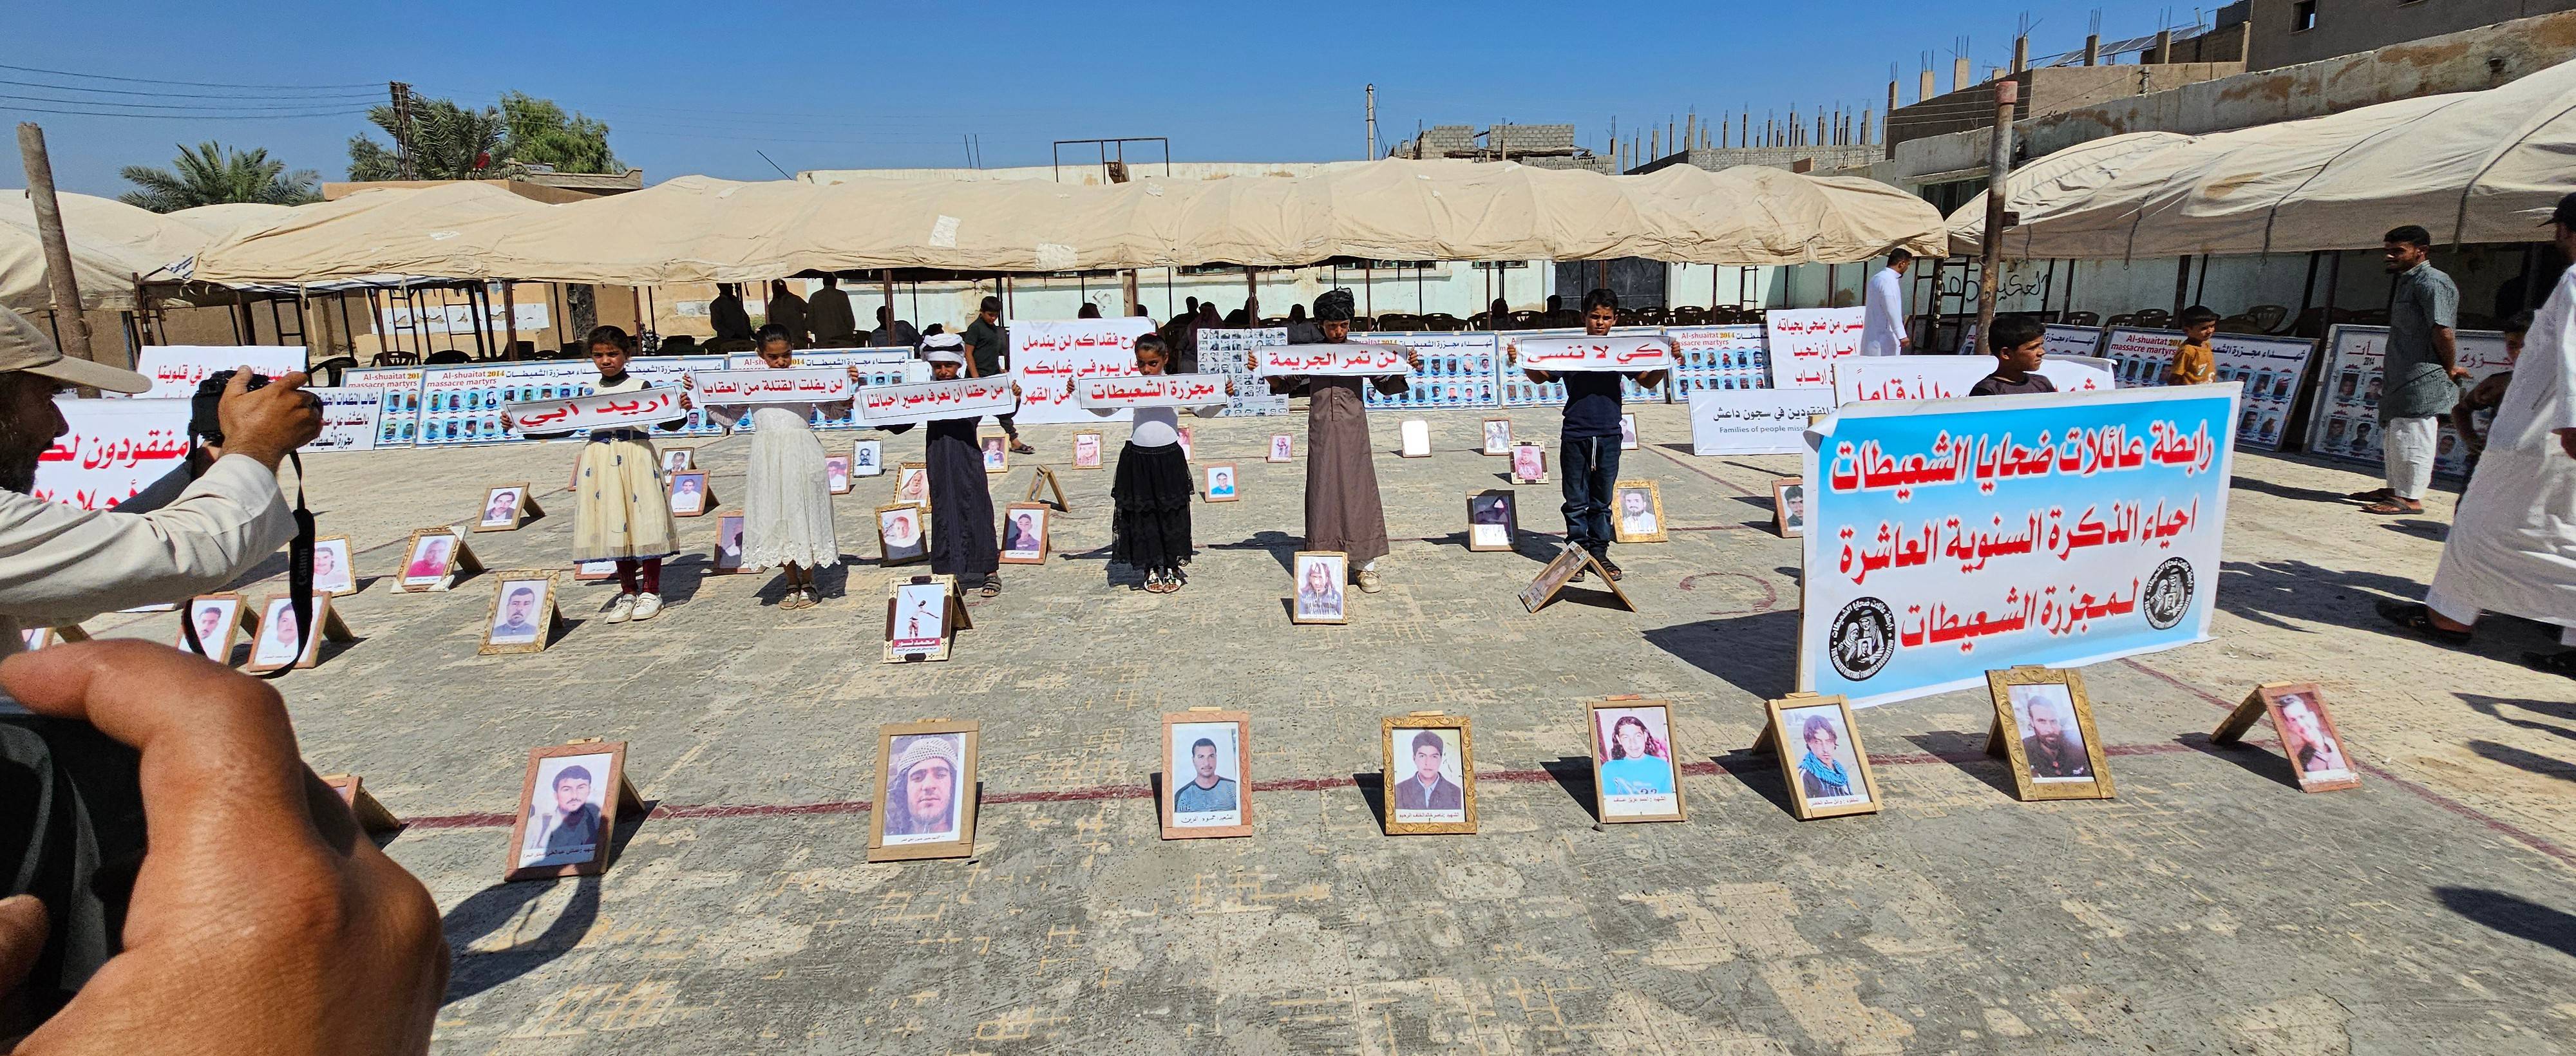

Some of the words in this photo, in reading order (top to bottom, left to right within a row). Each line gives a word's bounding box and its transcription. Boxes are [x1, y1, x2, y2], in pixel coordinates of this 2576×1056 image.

[1023, 334, 1056, 352] يندمل
[1059, 333, 1072, 351] لن
[1075, 332, 1119, 350] فقداكم
[1703, 339, 1729, 347] martyrs
[2126, 334, 2168, 346] Al-shuaitat
[1592, 344, 1609, 359] لا
[1616, 343, 1663, 364] كي
[2110, 343, 2145, 353] massacre
[2146, 346, 2177, 356] martyrs
[1269, 352, 1337, 371] الجريمة
[1340, 350, 1371, 369] تمر
[1376, 350, 1398, 369] لن
[364, 373, 406, 381] Al-shuaitat
[442, 371, 486, 379] Al-shuaitat
[1023, 359, 1074, 379] غيابكم
[1099, 363, 1120, 377] يوم
[466, 379, 497, 387] martyrs
[703, 380, 740, 397] العقاب
[743, 381, 760, 396] من
[762, 379, 795, 391] القتلة
[799, 378, 826, 393] يفلت
[829, 378, 843, 393] لن
[965, 384, 987, 399] حقنا
[990, 384, 1004, 400] من
[1091, 380, 1166, 402] الشعيطات
[1170, 380, 1215, 400] مجزرة
[596, 393, 669, 416] اريد
[902, 394, 925, 409] مصير
[927, 387, 951, 405] نعرف
[1023, 387, 1051, 406] القهر
[1713, 407, 1740, 421] داعش
[1774, 406, 1785, 421] في
[1760, 426, 1786, 435] people
[83, 429, 189, 470] مفقودون
[2058, 426, 2144, 474] عائلات
[2150, 420, 2213, 475] رابطة
[1832, 431, 1971, 499] الشعيطات
[1976, 431, 2053, 491] ضحايا
[2049, 500, 2138, 561] الذكرة
[2143, 496, 2197, 548] احياء
[1946, 511, 2043, 573] السنوية
[1840, 519, 1938, 585] العاشرة
[1900, 587, 2037, 651] الشعيطات
